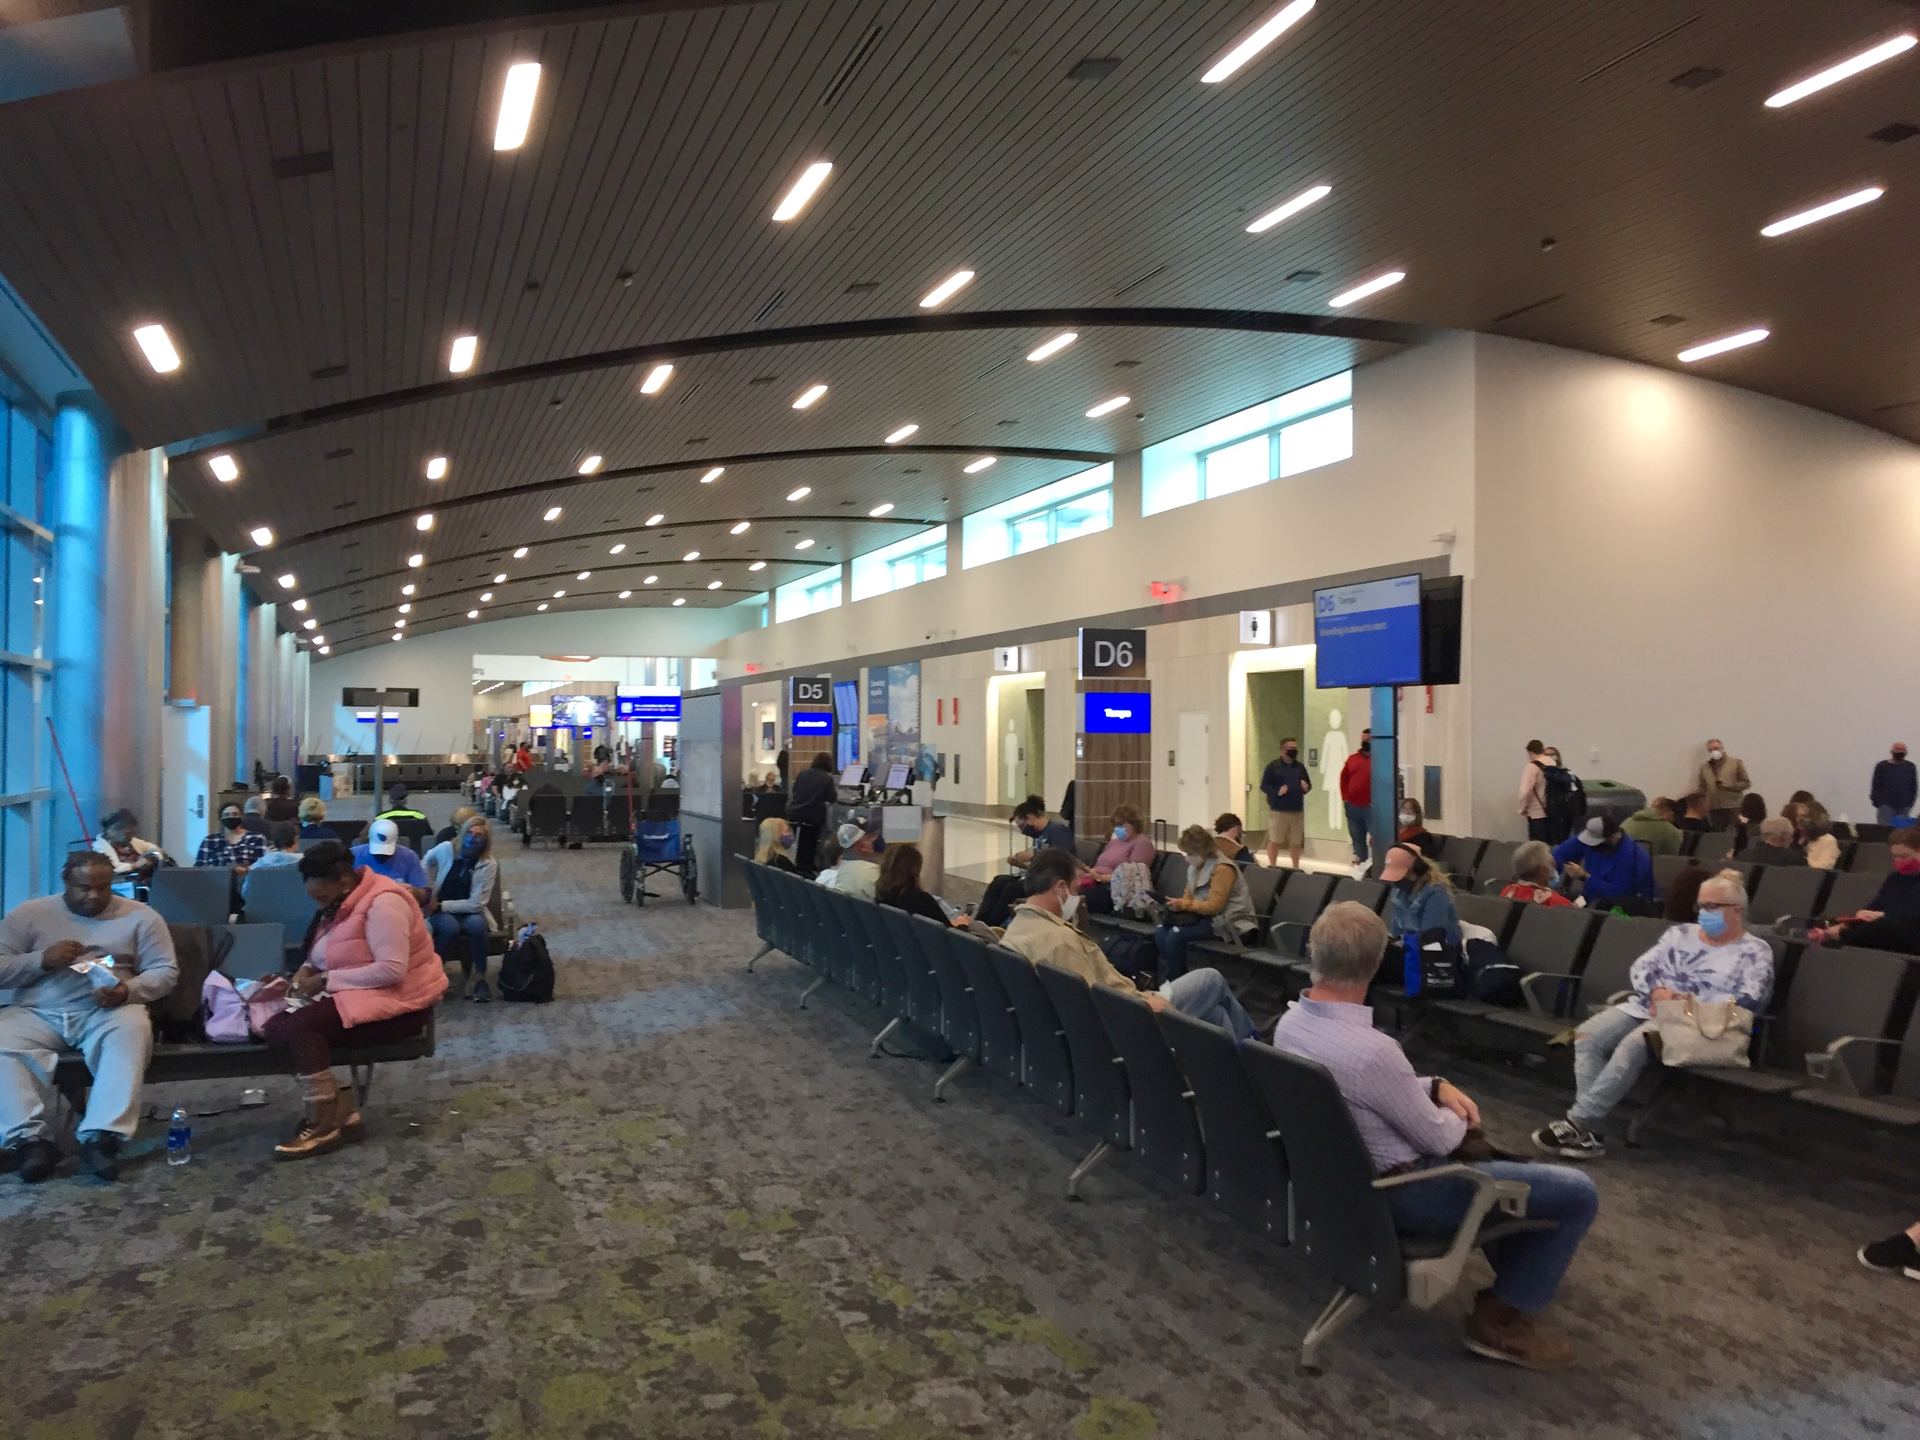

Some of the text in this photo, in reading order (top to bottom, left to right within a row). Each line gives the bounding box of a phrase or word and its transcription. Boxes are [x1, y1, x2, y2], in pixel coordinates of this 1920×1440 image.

[1318, 595, 1336, 613] D6
[1094, 640, 1134, 668] D6
[798, 683, 823, 699] D5
